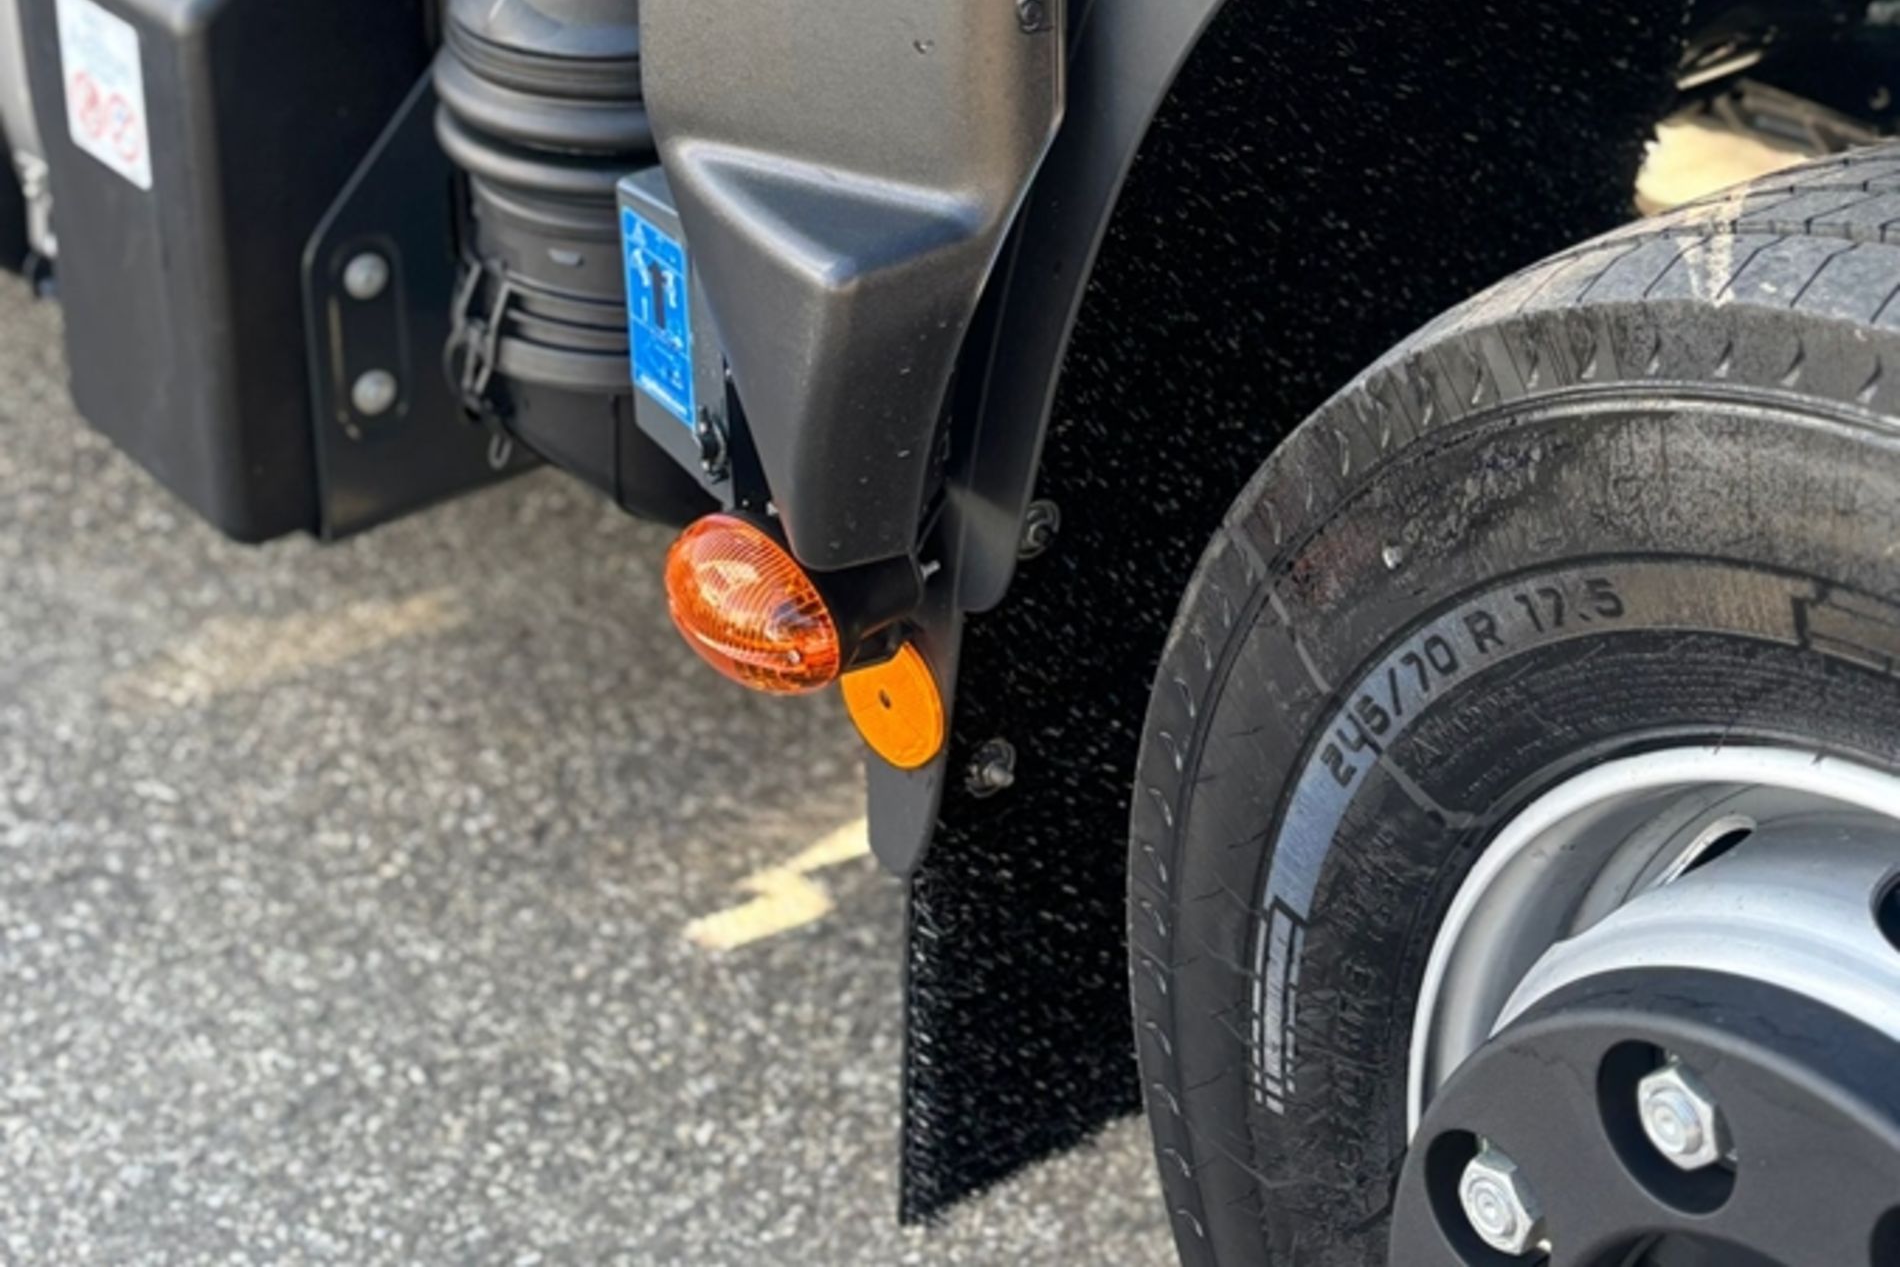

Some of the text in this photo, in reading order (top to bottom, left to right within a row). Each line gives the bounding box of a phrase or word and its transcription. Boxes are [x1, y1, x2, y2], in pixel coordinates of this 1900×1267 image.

[1320, 635, 1459, 788] 245/70
[1463, 609, 1504, 654] R
[1513, 577, 1625, 633] 17.5
